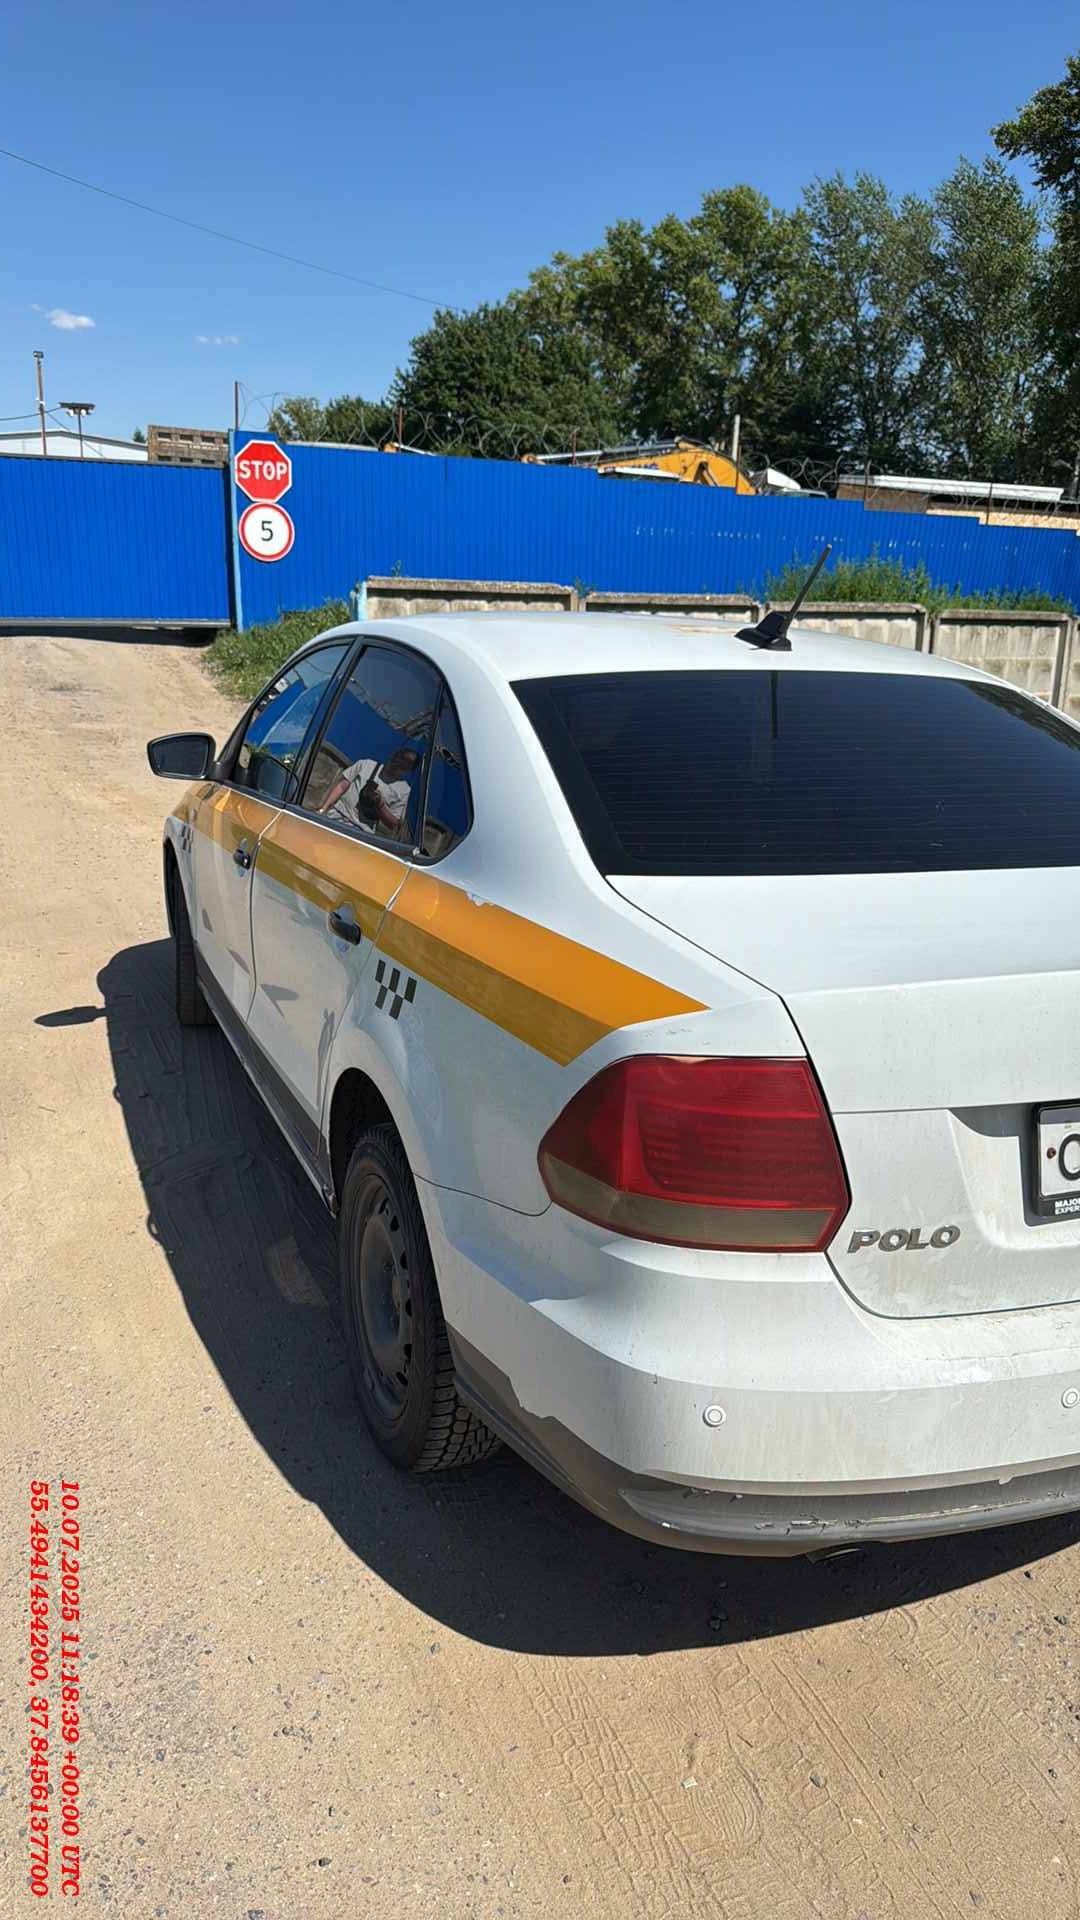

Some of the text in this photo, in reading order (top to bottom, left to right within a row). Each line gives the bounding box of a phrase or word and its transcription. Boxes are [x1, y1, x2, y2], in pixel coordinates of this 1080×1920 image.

[239, 460, 287, 480] STOP
[261, 520, 273, 541] 5
[847, 1225, 960, 1253] POLO
